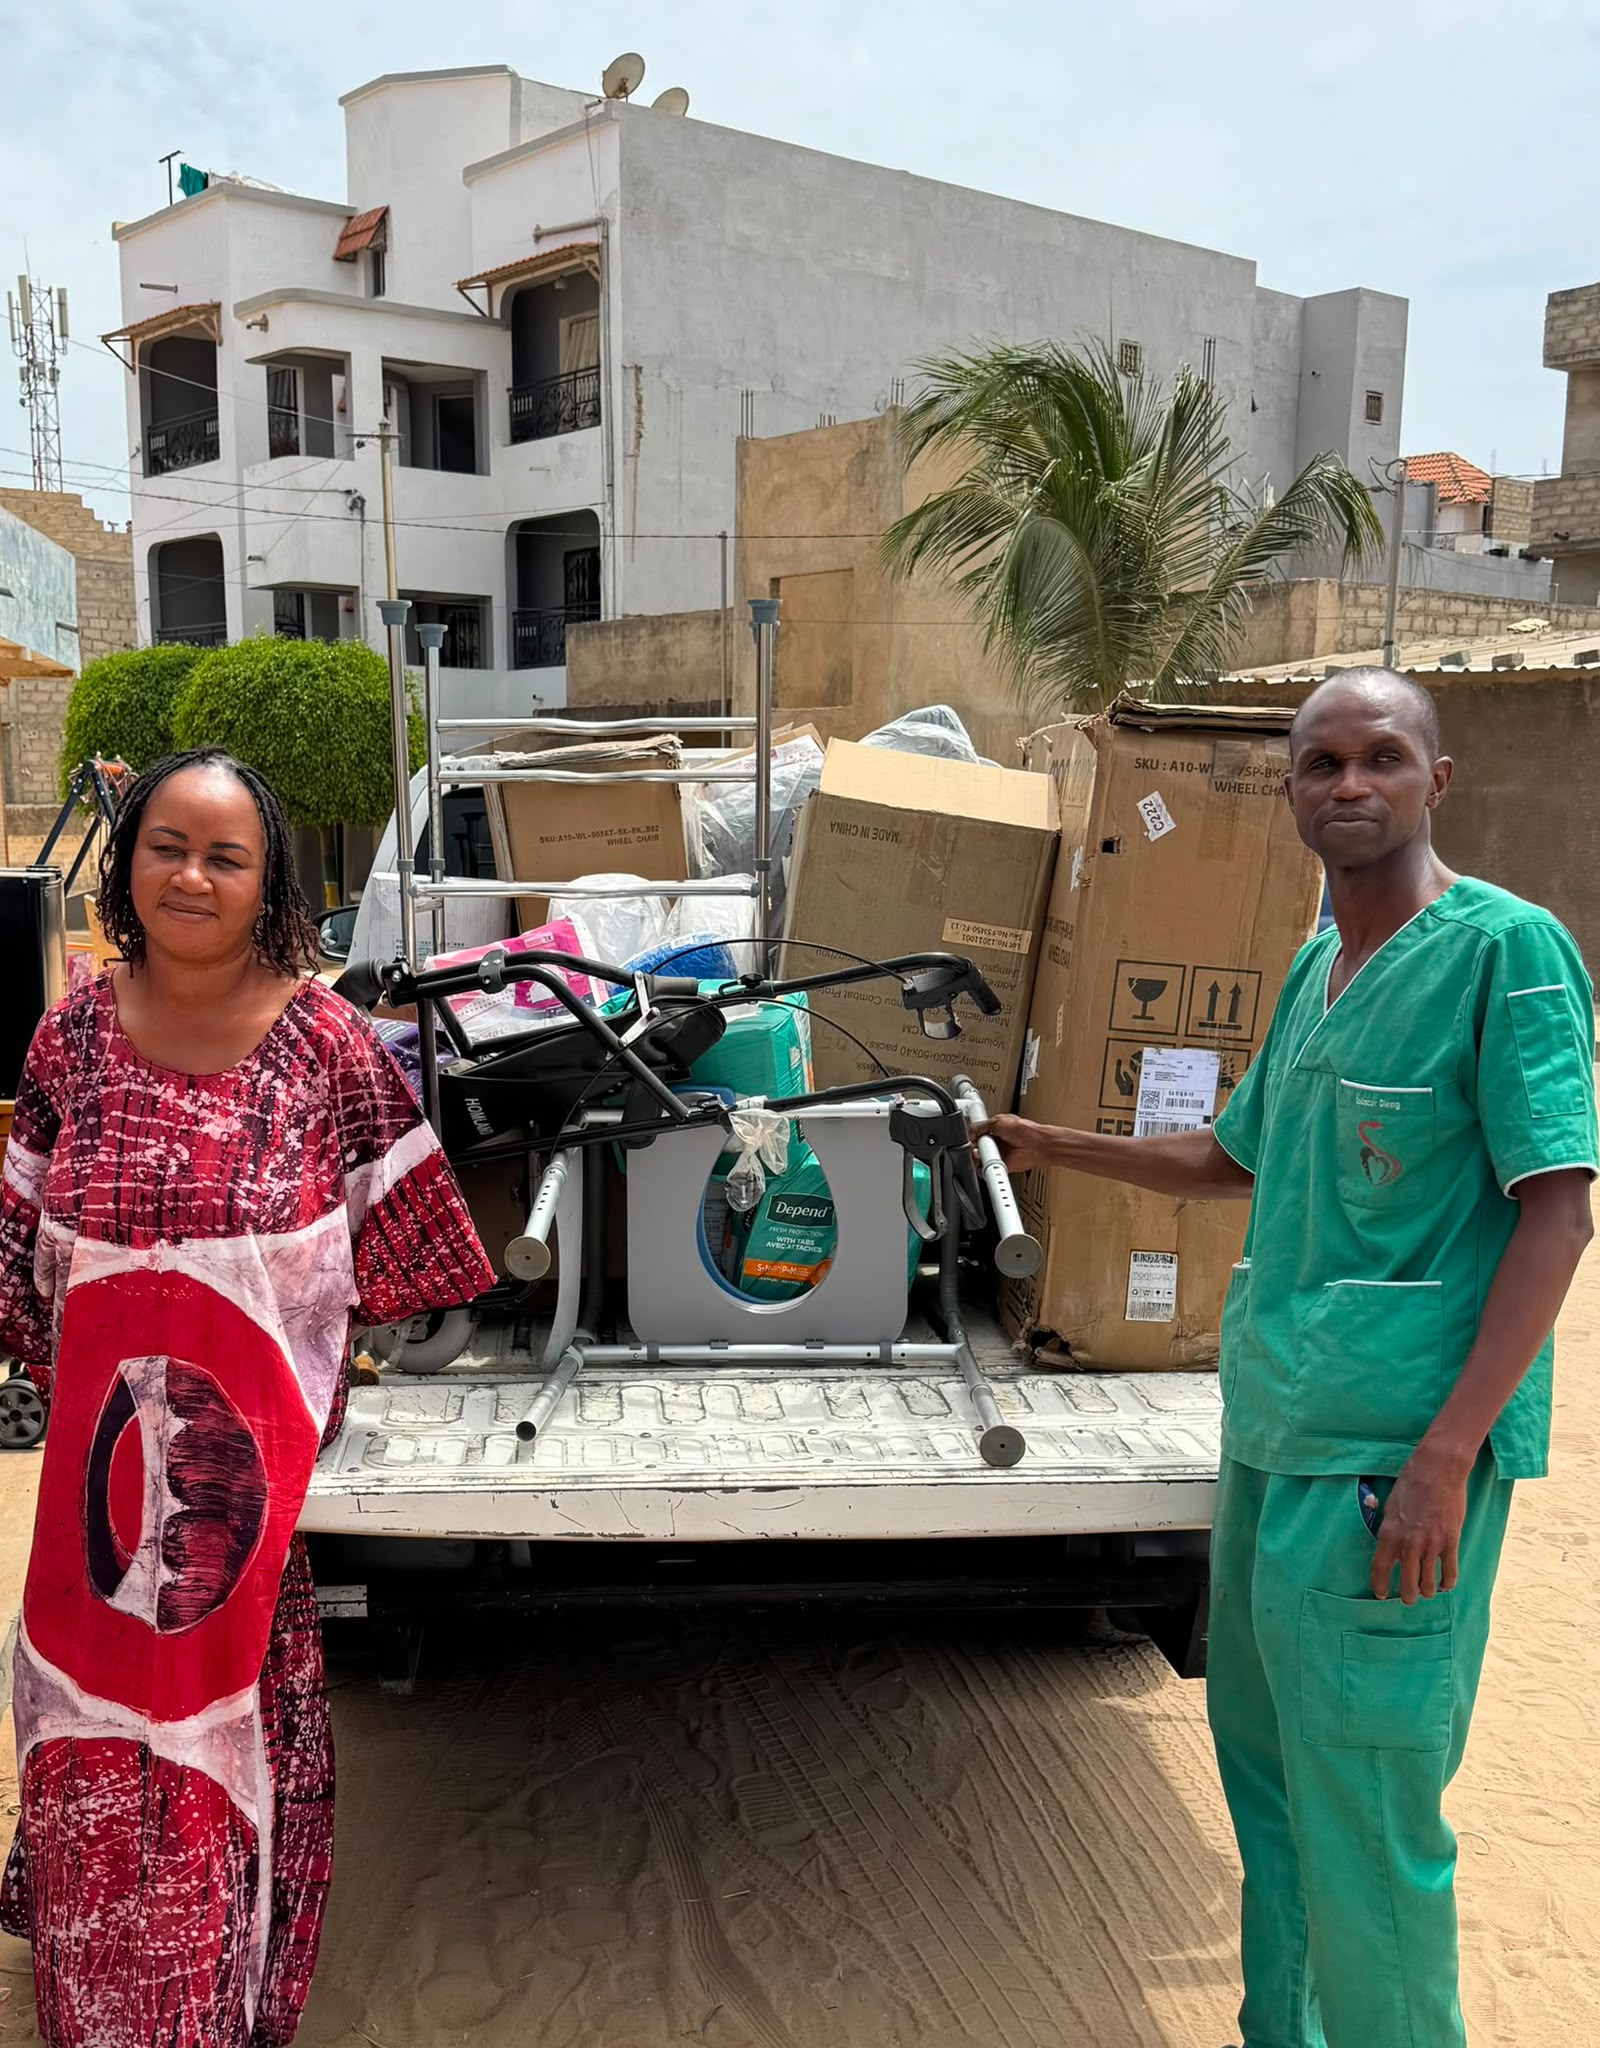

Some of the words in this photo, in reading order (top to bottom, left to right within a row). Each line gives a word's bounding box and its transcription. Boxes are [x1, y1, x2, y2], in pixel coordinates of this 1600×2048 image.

[1134, 757, 1159, 771] SKU
[1214, 780, 1259, 796] WHEEL
[1261, 783, 1287, 798] CHA
[1142, 800, 1165, 832] C222
[830, 821, 859, 837] CHINA
[860, 825, 871, 839] IN
[871, 827, 900, 844] MADE
[606, 838, 633, 847] WHEEL
[636, 834, 659, 844] CHAIR
[844, 992, 882, 1006] Combat
[775, 1201, 828, 1219] Depend
[768, 1226, 788, 1234] FRESH
[788, 1228, 825, 1238] PROTECTION
[766, 1241, 786, 1250] AVEC
[785, 1243, 823, 1253] ATTACHES
[776, 1236, 796, 1244] WITH
[796, 1238, 816, 1246] TABS
